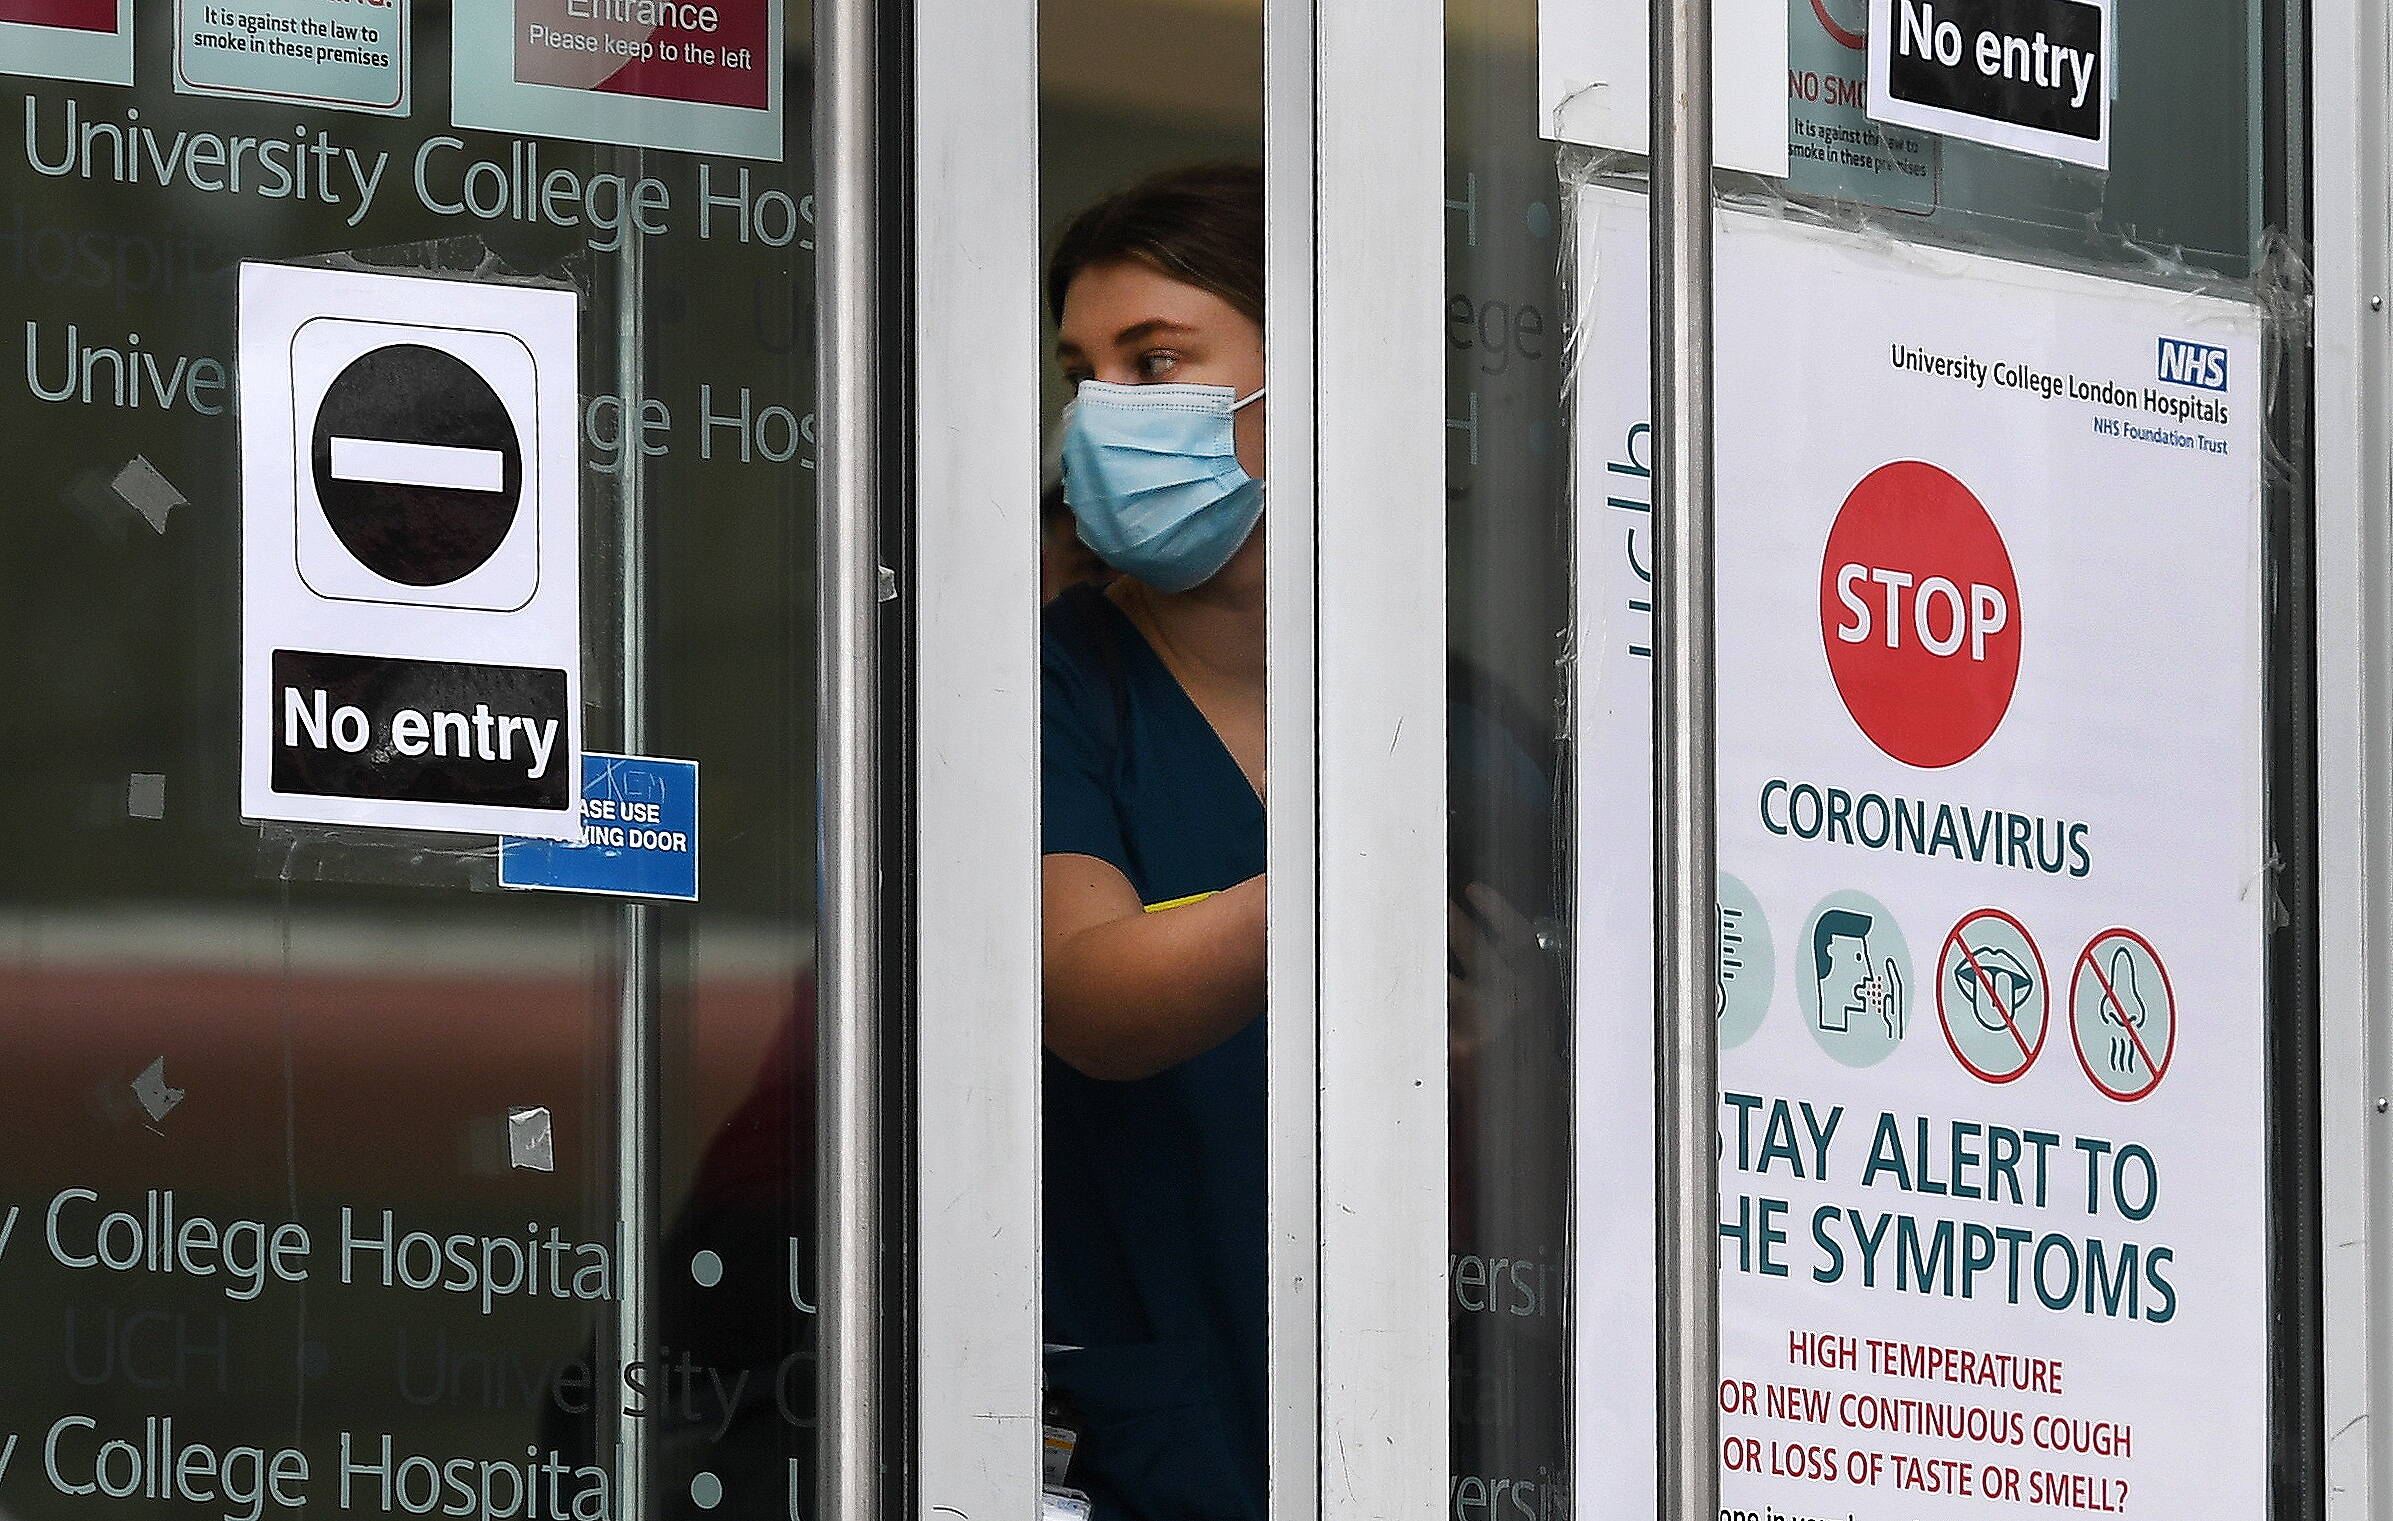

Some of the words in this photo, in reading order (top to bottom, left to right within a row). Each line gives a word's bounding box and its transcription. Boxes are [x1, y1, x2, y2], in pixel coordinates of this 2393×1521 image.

[194, 32, 246, 50] smoke
[250, 35, 265, 53] in
[269, 37, 312, 59] these
[316, 47, 389, 68] premises
[204, 5, 217, 24] It
[221, 8, 234, 26] is
[238, 13, 297, 34] against
[301, 18, 327, 37] the
[331, 20, 358, 40] law
[361, 26, 378, 43] to
[529, 24, 599, 52] Please
[604, 34, 652, 63] keep
[659, 40, 678, 61] to
[684, 43, 715, 66] the
[721, 47, 752, 70] left
[567, 0, 718, 32] Entrance
[1900, 0, 1962, 66] No
[1975, 30, 2095, 108] entry
[1825, 75, 1865, 109] SM
[1788, 143, 1824, 161] smoke
[1827, 145, 1838, 162] in
[1840, 149, 1873, 168] these
[1795, 118, 1804, 135] It
[1806, 119, 1816, 137] is
[1818, 124, 1861, 144] against
[25, 95, 389, 227] University
[413, 136, 670, 252] College
[27, 319, 225, 416] Unive
[1892, 343, 1987, 388] University
[1994, 362, 2063, 399] College
[2069, 374, 2137, 410] London
[2144, 387, 2228, 425] Hospitals
[2160, 341, 2226, 389] NHS
[2094, 416, 2120, 437] NHS
[2124, 421, 2194, 449] Foundation
[2198, 434, 2228, 455] Trust
[1837, 563, 2009, 662] STOP
[284, 687, 370, 753] No
[391, 704, 559, 779] entry
[621, 801, 660, 823] USE
[629, 829, 688, 852] DOOR
[1760, 779, 2092, 878] CORONAVIRUS
[1718, 1092, 1844, 1181] TAY
[1862, 1112, 2060, 1208] ALERT
[2075, 1137, 2158, 1222] TO
[46, 1187, 311, 1300] College
[341, 1207, 626, 1315] Hospital
[1812, 1205, 2175, 1325] SYMPTOMS
[1789, 1330, 1857, 1372] HIGH
[1866, 1339, 2063, 1394] TEMPERATURE
[1719, 1380, 1758, 1415] OR
[1766, 1384, 1831, 1424] NEW
[1839, 1394, 2024, 1447] CONTINUOUS
[2034, 1416, 2131, 1458] COUGH
[45, 1415, 310, 1521] College
[340, 1432, 625, 1521] Hospital
[1723, 1437, 1762, 1473] OR
[1771, 1441, 1838, 1481] LOSS
[1847, 1450, 1884, 1487] OF
[1890, 1454, 1973, 1497] TASTE
[1982, 1466, 2020, 1502] OR
[2030, 1471, 2129, 1513] SMELL?
